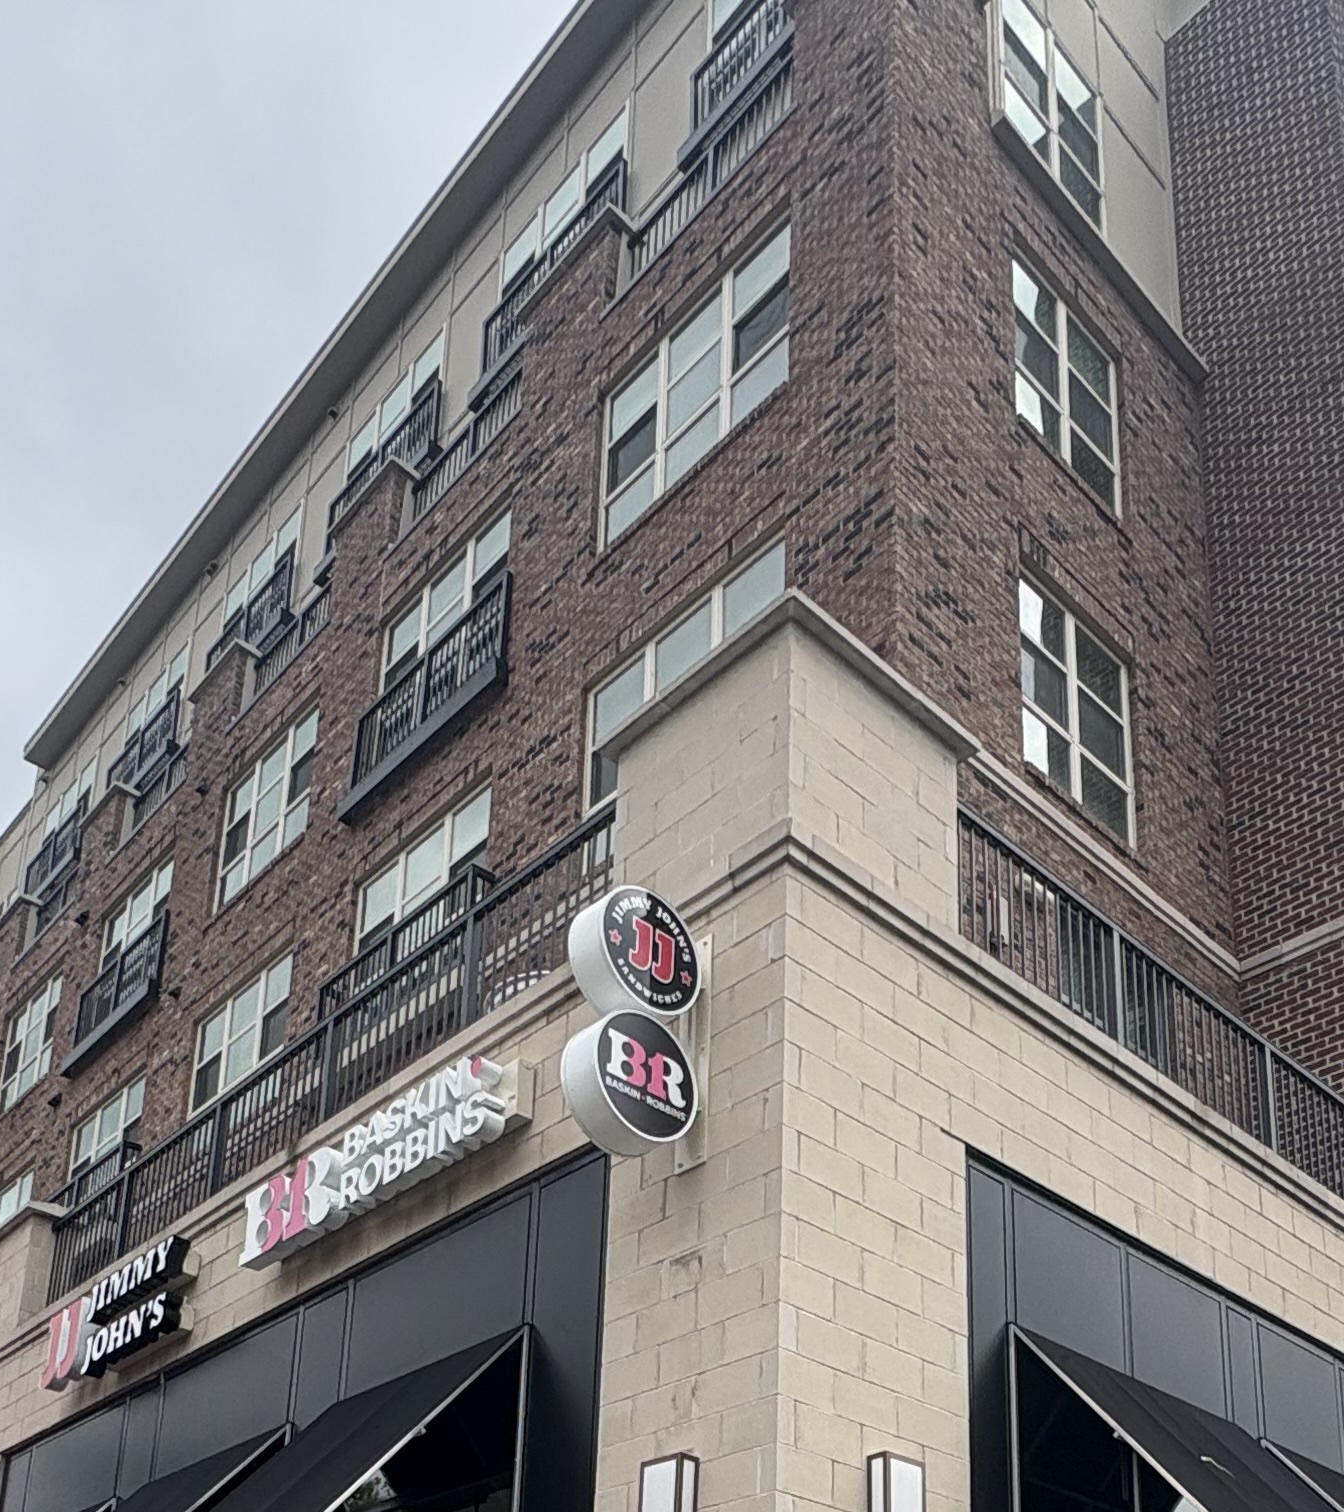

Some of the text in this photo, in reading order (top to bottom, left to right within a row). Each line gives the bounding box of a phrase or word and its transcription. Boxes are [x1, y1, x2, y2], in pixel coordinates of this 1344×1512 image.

[611, 894, 692, 964] JIMMY JOHN'S
[628, 915, 675, 985] JJ
[616, 957, 683, 1005] SANDWICHES
[606, 1075, 687, 1123] BASKIN ROBBINS
[607, 1027, 687, 1109] BR
[338, 1091, 487, 1210] ROBBINS
[342, 1056, 478, 1167] BASKIN
[238, 1147, 342, 1268] BR
[86, 1235, 175, 1323] JIMMY
[40, 1296, 84, 1389] JJ
[80, 1291, 167, 1376] JOHN'S
